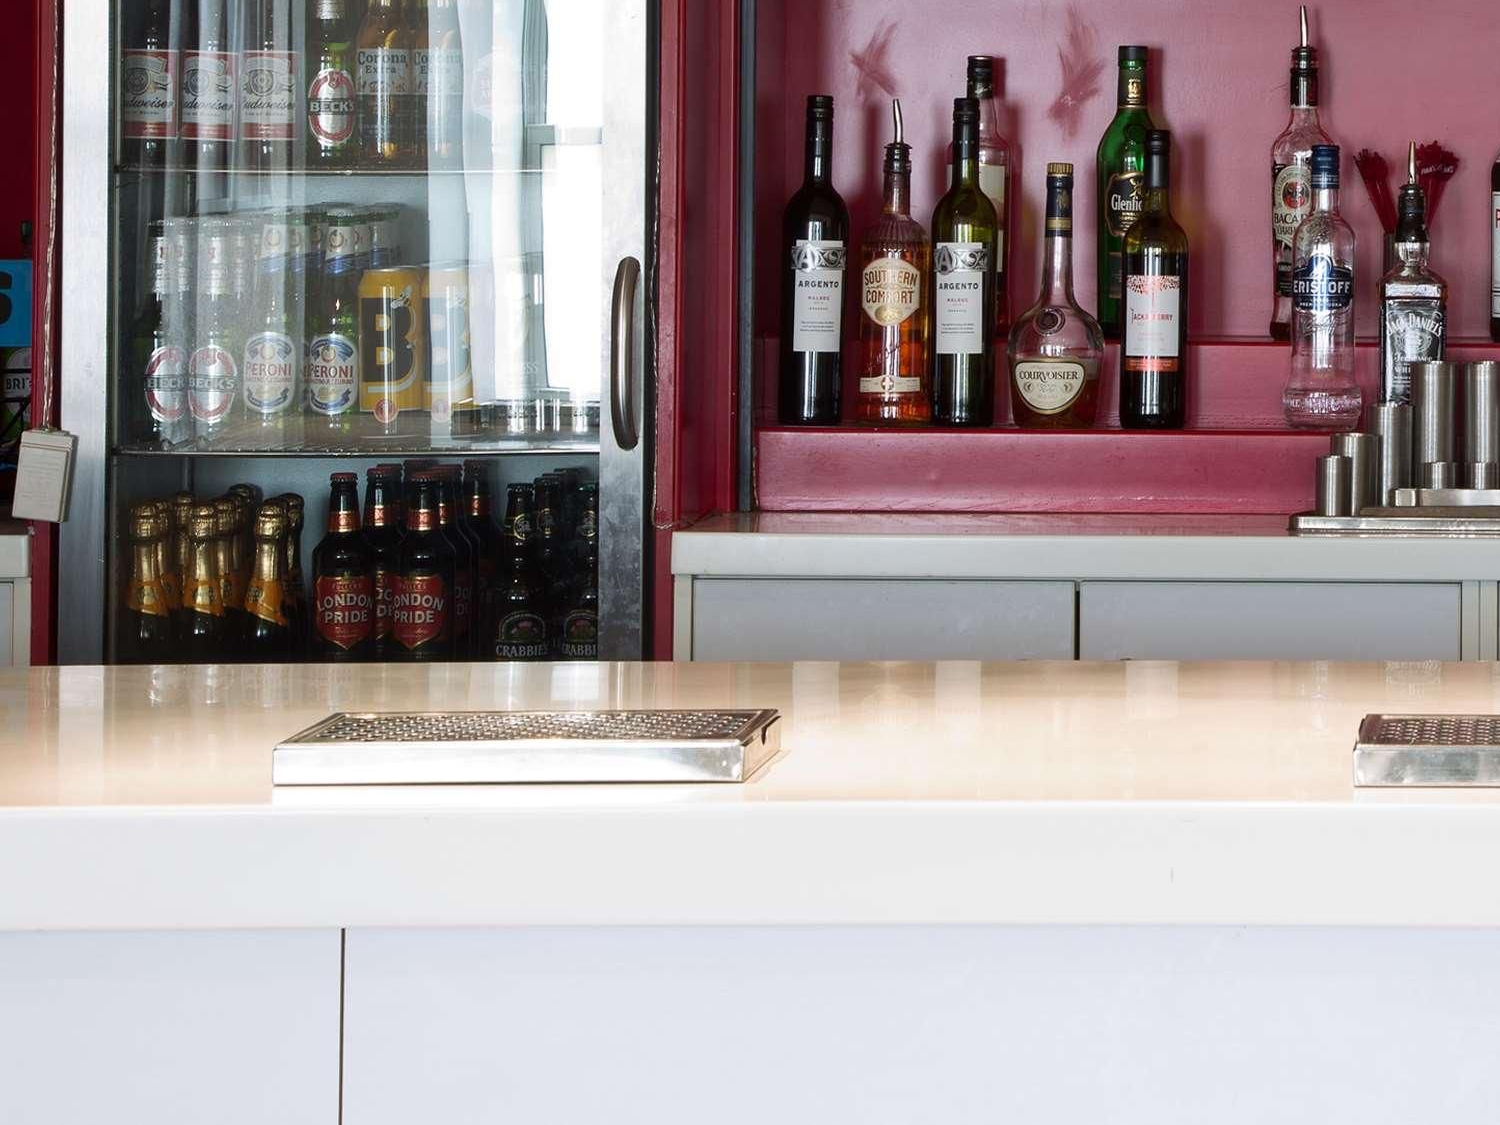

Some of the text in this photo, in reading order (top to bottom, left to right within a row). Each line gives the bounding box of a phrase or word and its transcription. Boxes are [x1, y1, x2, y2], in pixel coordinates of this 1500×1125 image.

[358, 51, 407, 65] Corona
[1294, 281, 1351, 293] ERISTOFF
[1409, 313, 1442, 337] DANIEL'S
[246, 363, 291, 376] PERONI
[311, 363, 353, 377] PERONI
[1020, 371, 1078, 383] COURVOISIER
[317, 593, 372, 612] LONDON
[393, 593, 444, 611] ONDON
[325, 610, 368, 624] PRIDE
